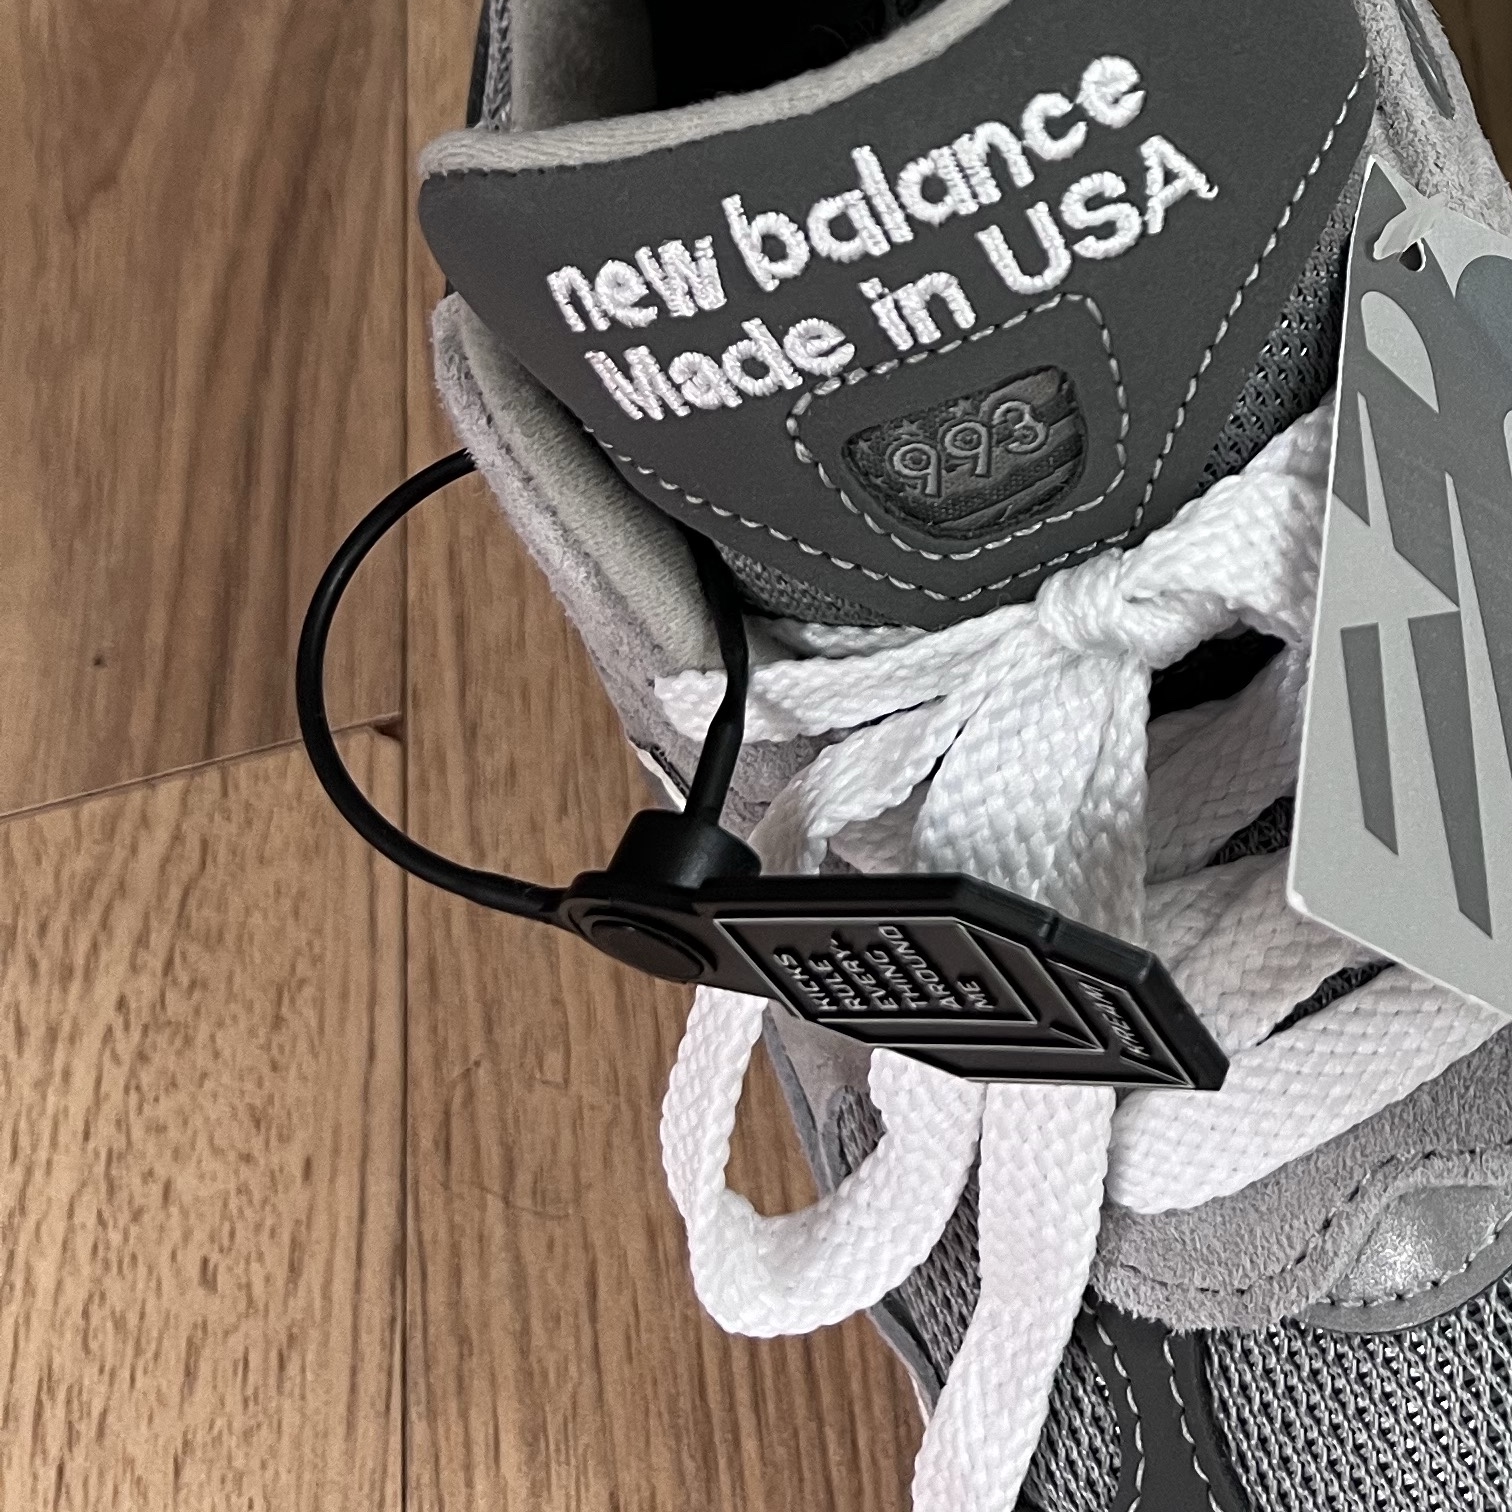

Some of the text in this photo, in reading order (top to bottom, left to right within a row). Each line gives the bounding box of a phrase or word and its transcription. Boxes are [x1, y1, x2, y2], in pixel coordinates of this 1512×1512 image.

[545, 54, 1147, 333] new balance
[584, 133, 1219, 421] Made in USA
[892, 400, 1048, 496] 993
